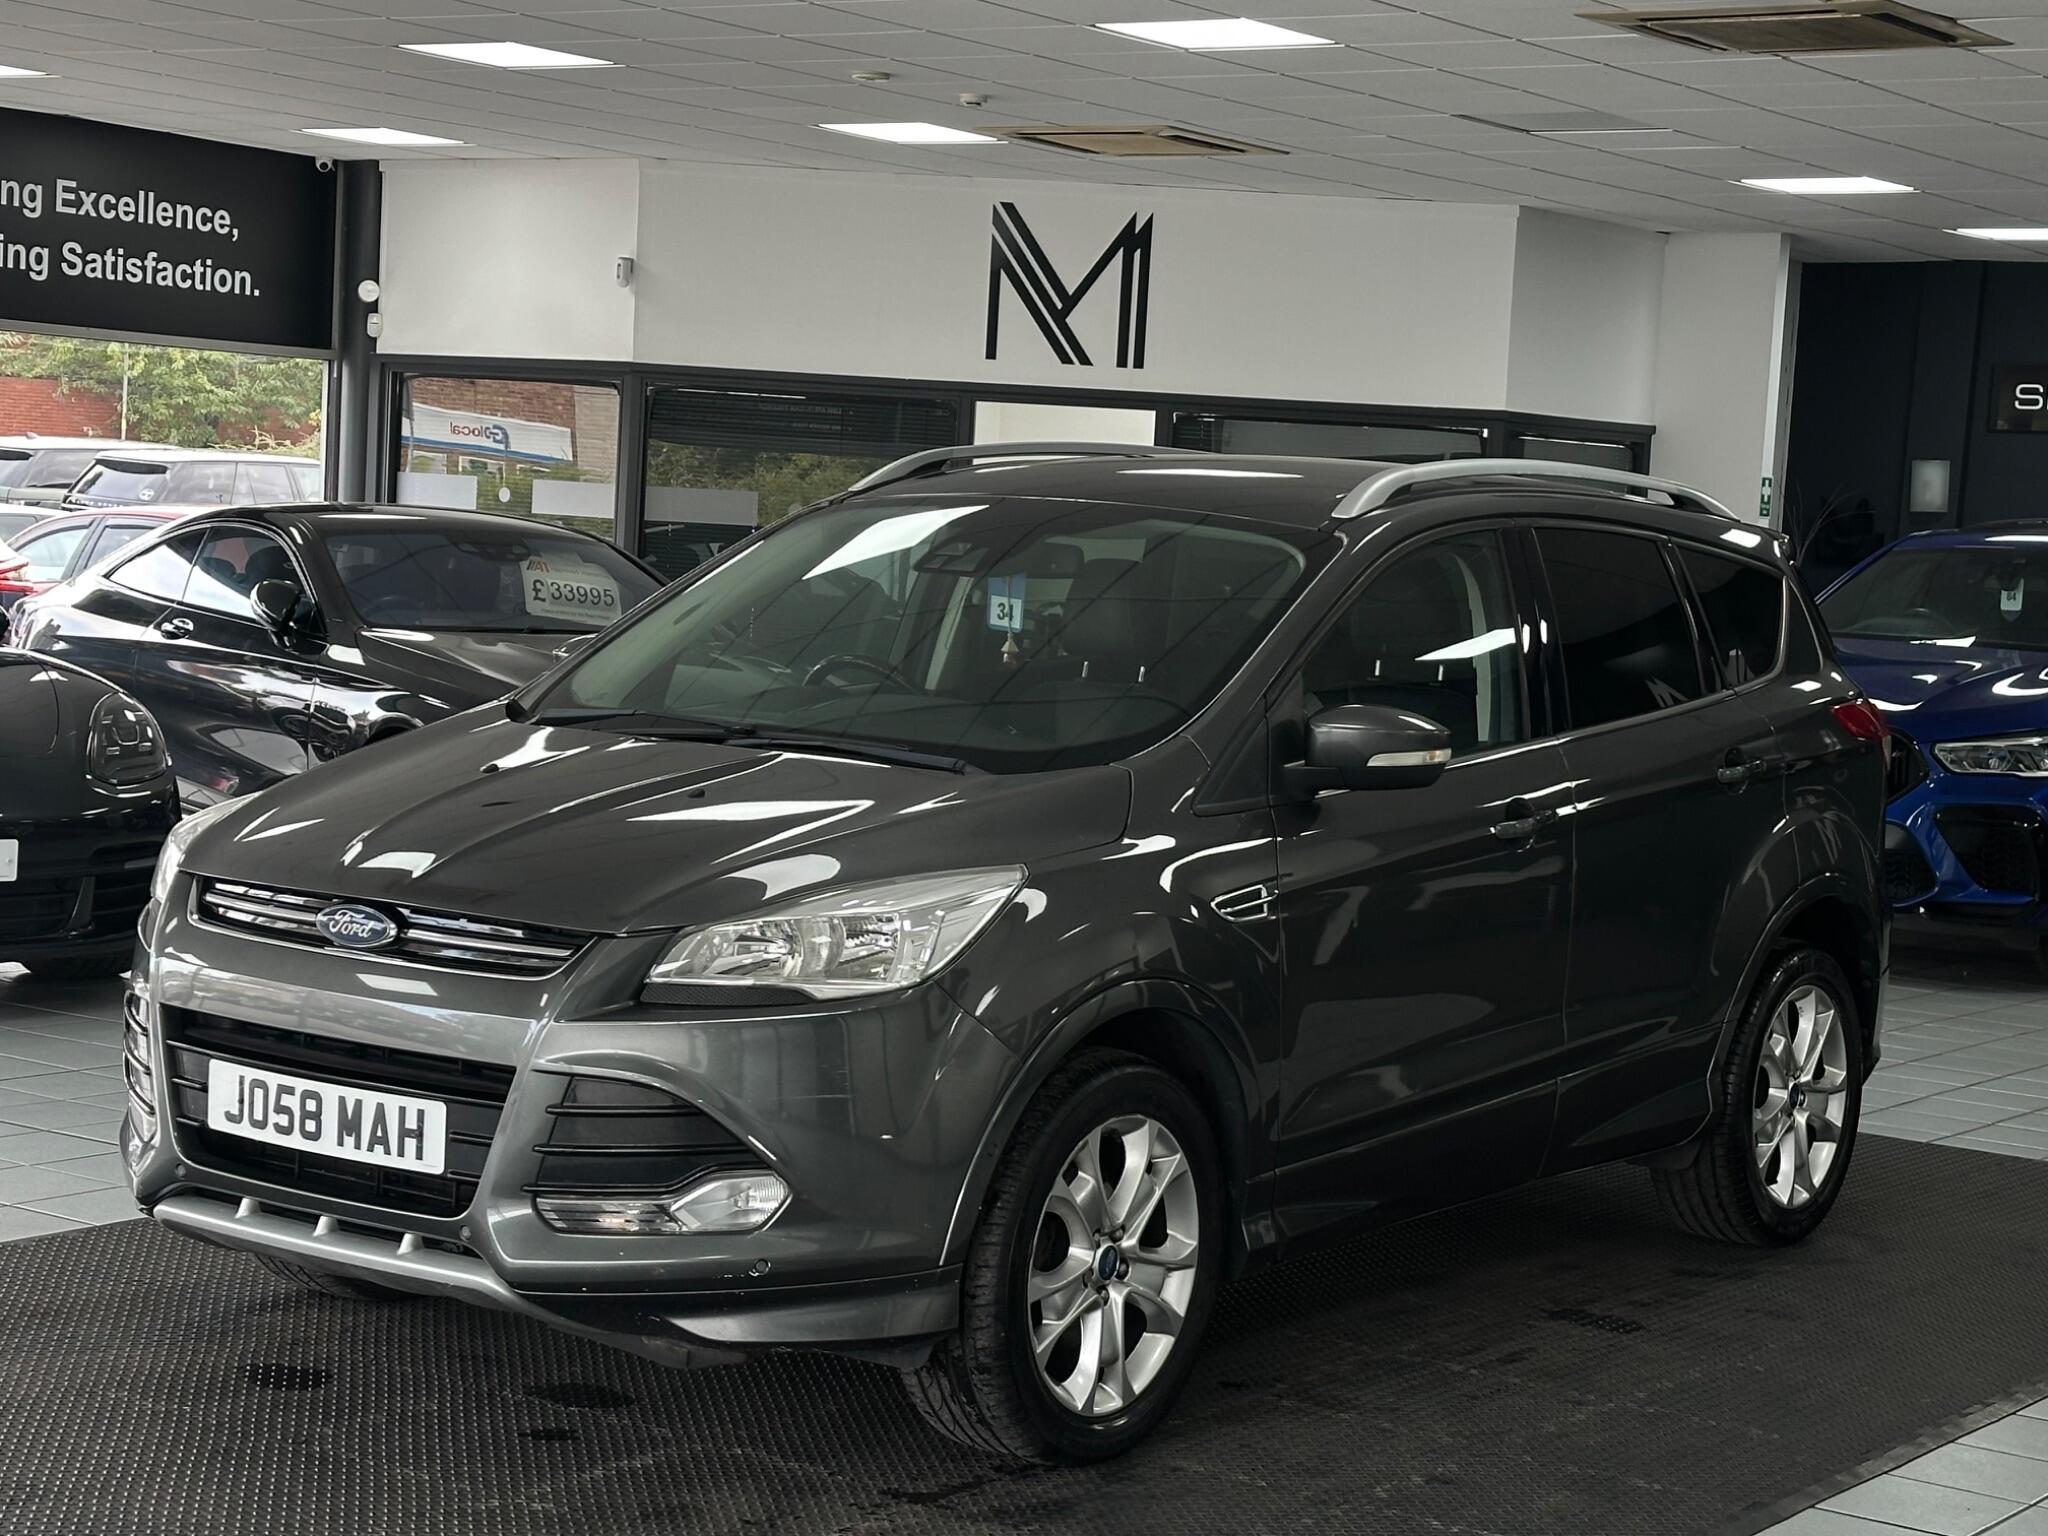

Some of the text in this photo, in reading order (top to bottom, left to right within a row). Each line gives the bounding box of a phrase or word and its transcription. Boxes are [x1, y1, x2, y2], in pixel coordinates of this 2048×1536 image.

[55, 178, 240, 242] Excellence,
[60, 241, 260, 297] Satisfaction.
[2013, 383, 2048, 411] S
[531, 579, 615, 607] £33995
[327, 909, 373, 938] Ford
[336, 1095, 425, 1161] MAH
